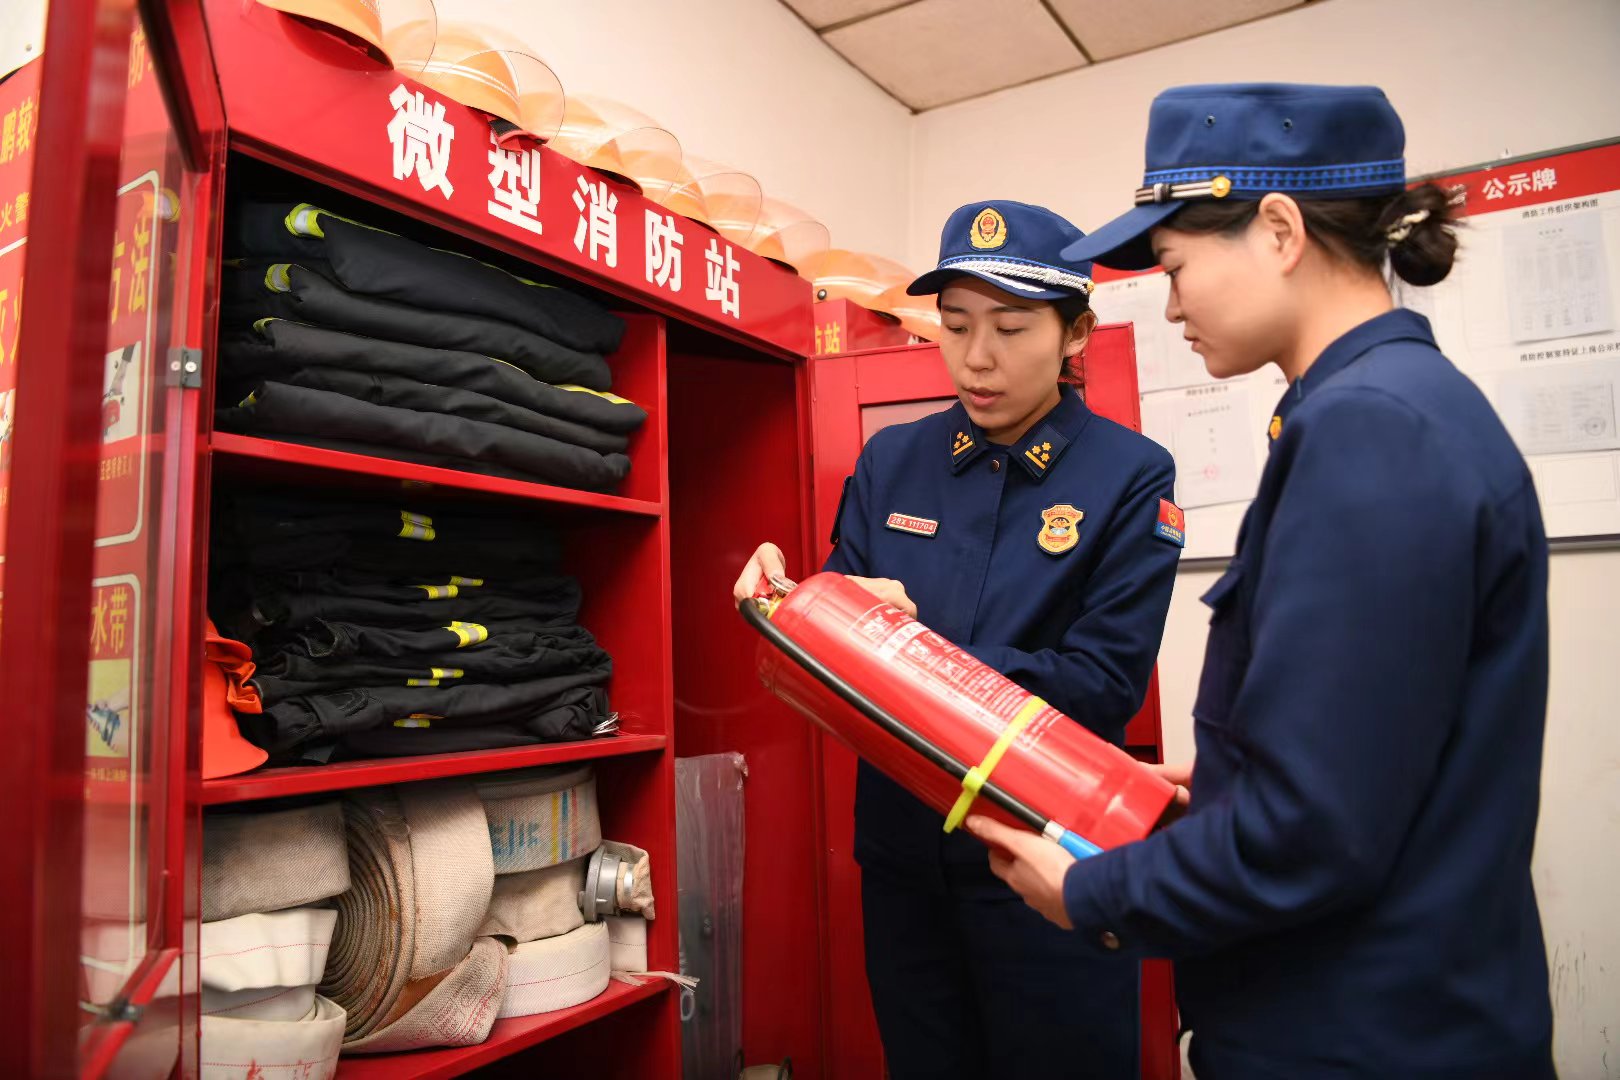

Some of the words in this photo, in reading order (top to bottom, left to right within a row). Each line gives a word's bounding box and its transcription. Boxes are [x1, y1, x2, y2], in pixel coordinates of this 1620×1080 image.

[386, 83, 741, 319] 微型消防站
[1481, 168, 1558, 200] 公示牌
[90, 587, 128, 655] 水带
